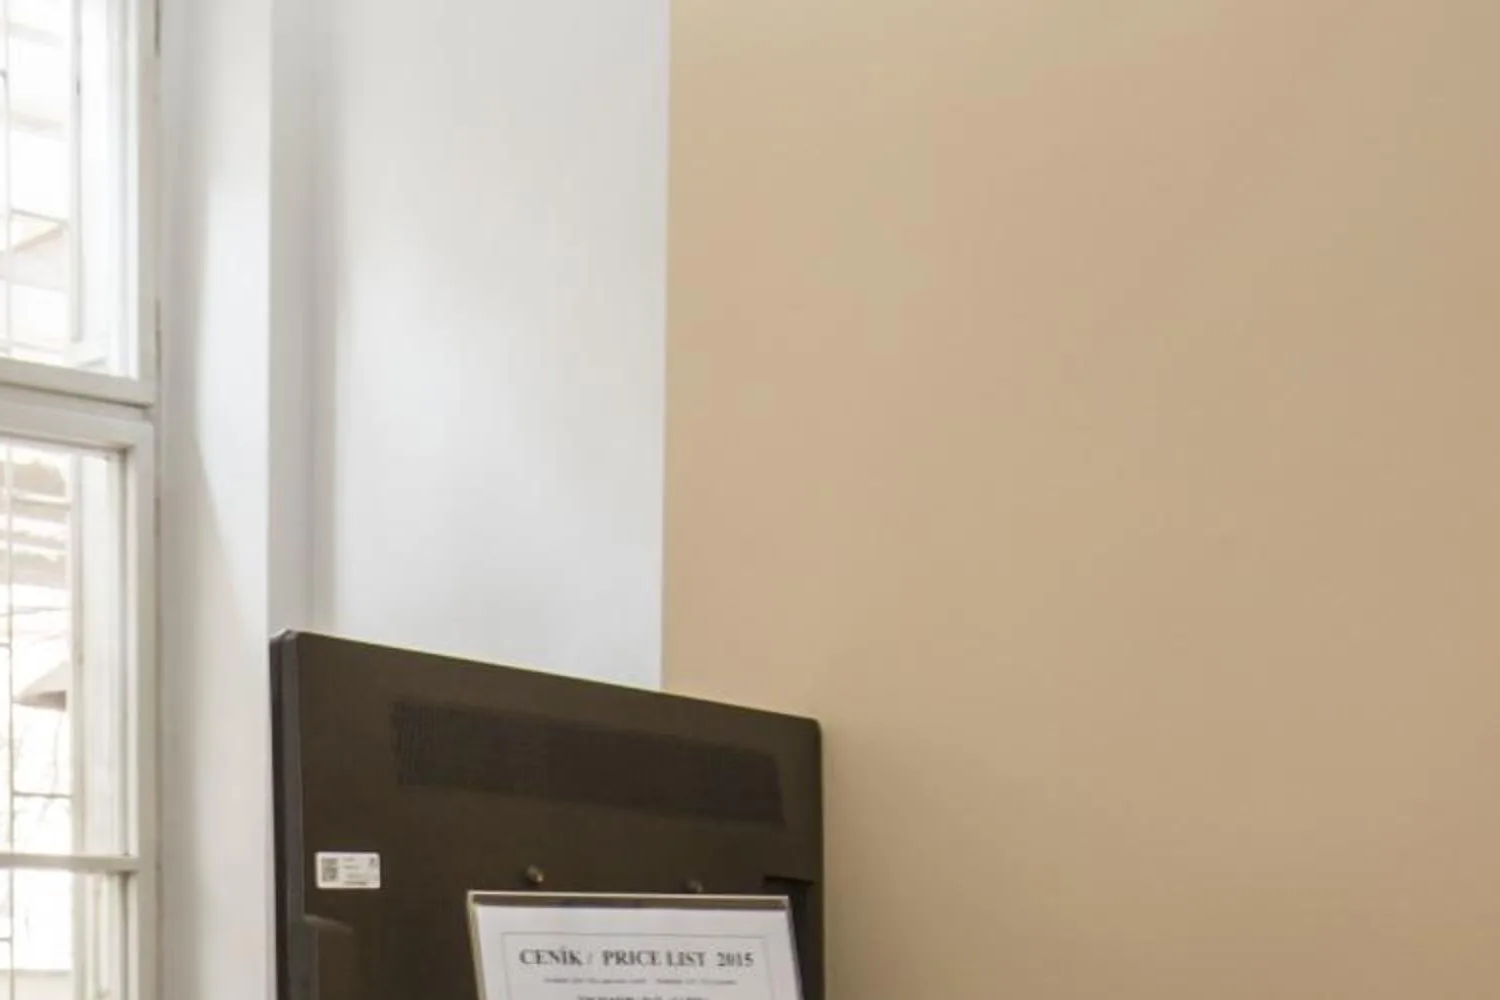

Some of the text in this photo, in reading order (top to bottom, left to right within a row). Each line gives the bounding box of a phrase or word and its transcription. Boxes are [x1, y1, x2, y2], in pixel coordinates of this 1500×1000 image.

[518, 945, 583, 966] CENÍK
[602, 950, 662, 967] PRICE
[666, 951, 706, 968] LIST
[716, 952, 754, 968] 2015
